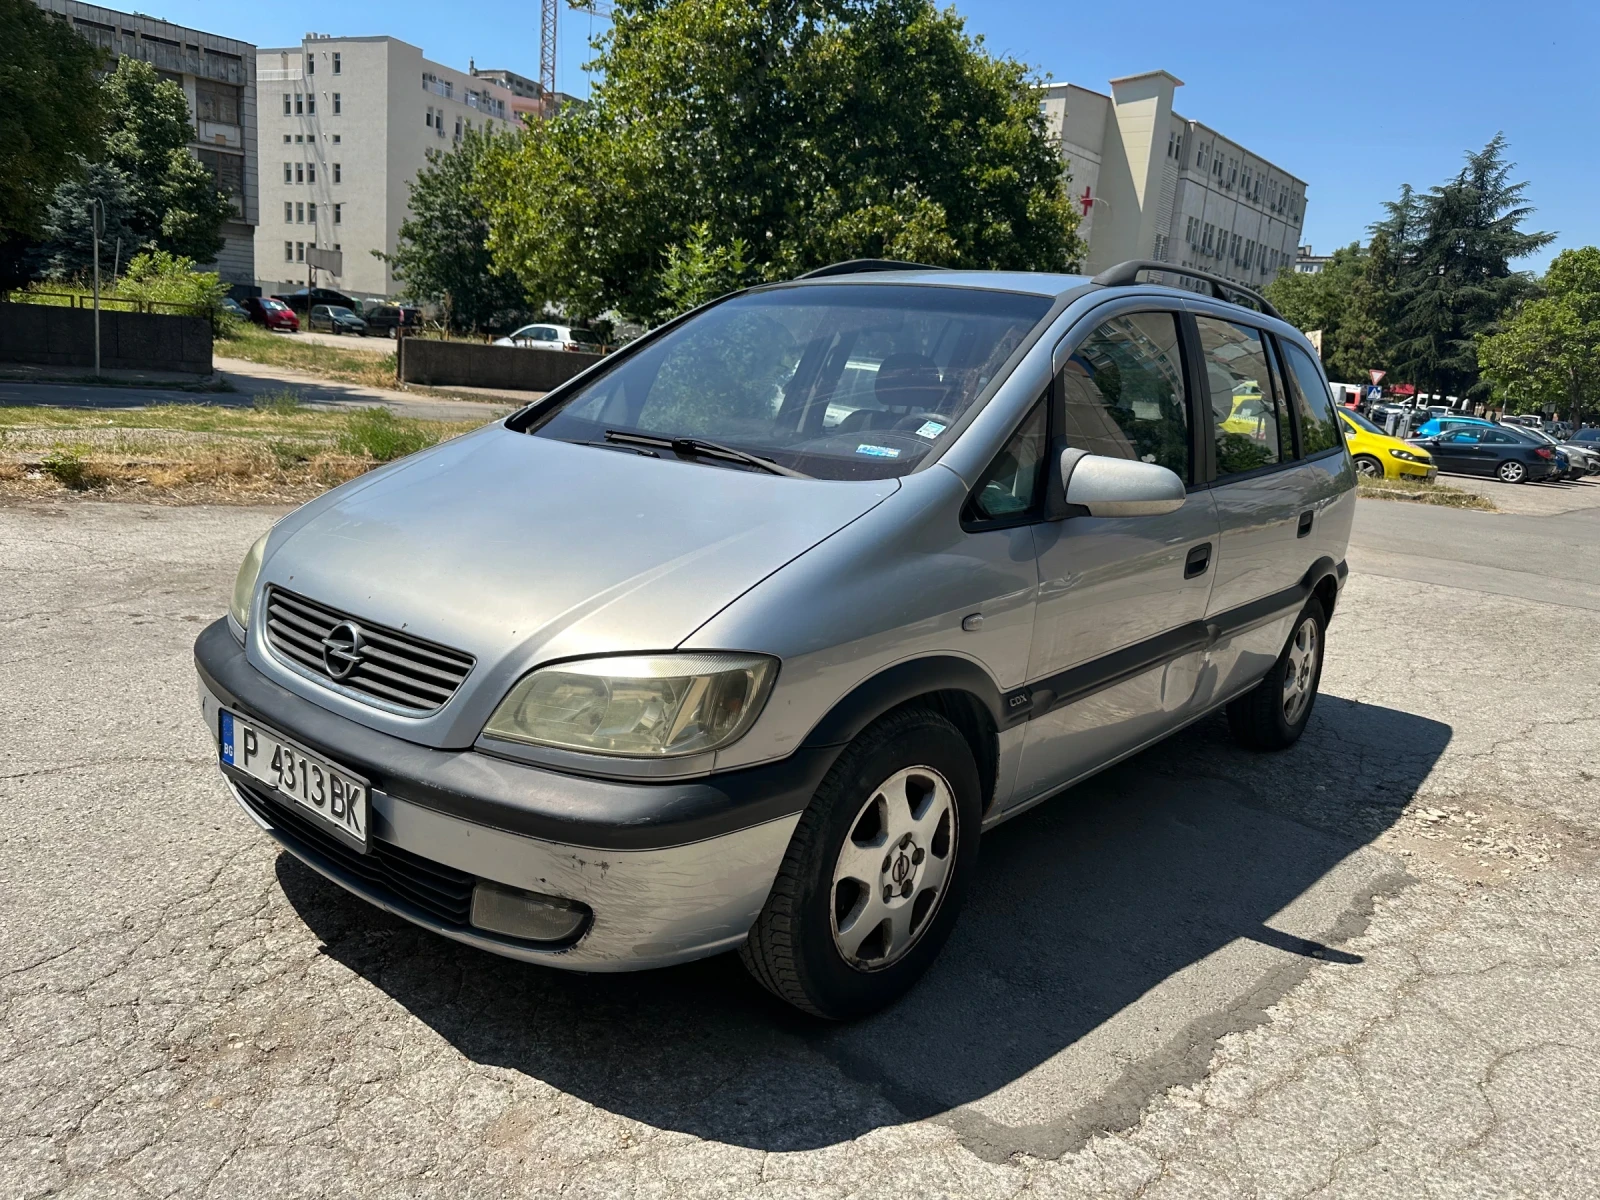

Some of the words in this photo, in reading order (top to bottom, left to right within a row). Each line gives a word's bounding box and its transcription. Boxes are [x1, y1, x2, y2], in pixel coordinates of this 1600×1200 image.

[1009, 693, 1028, 707] CDX
[223, 742, 234, 758] BG
[243, 726, 258, 768] P
